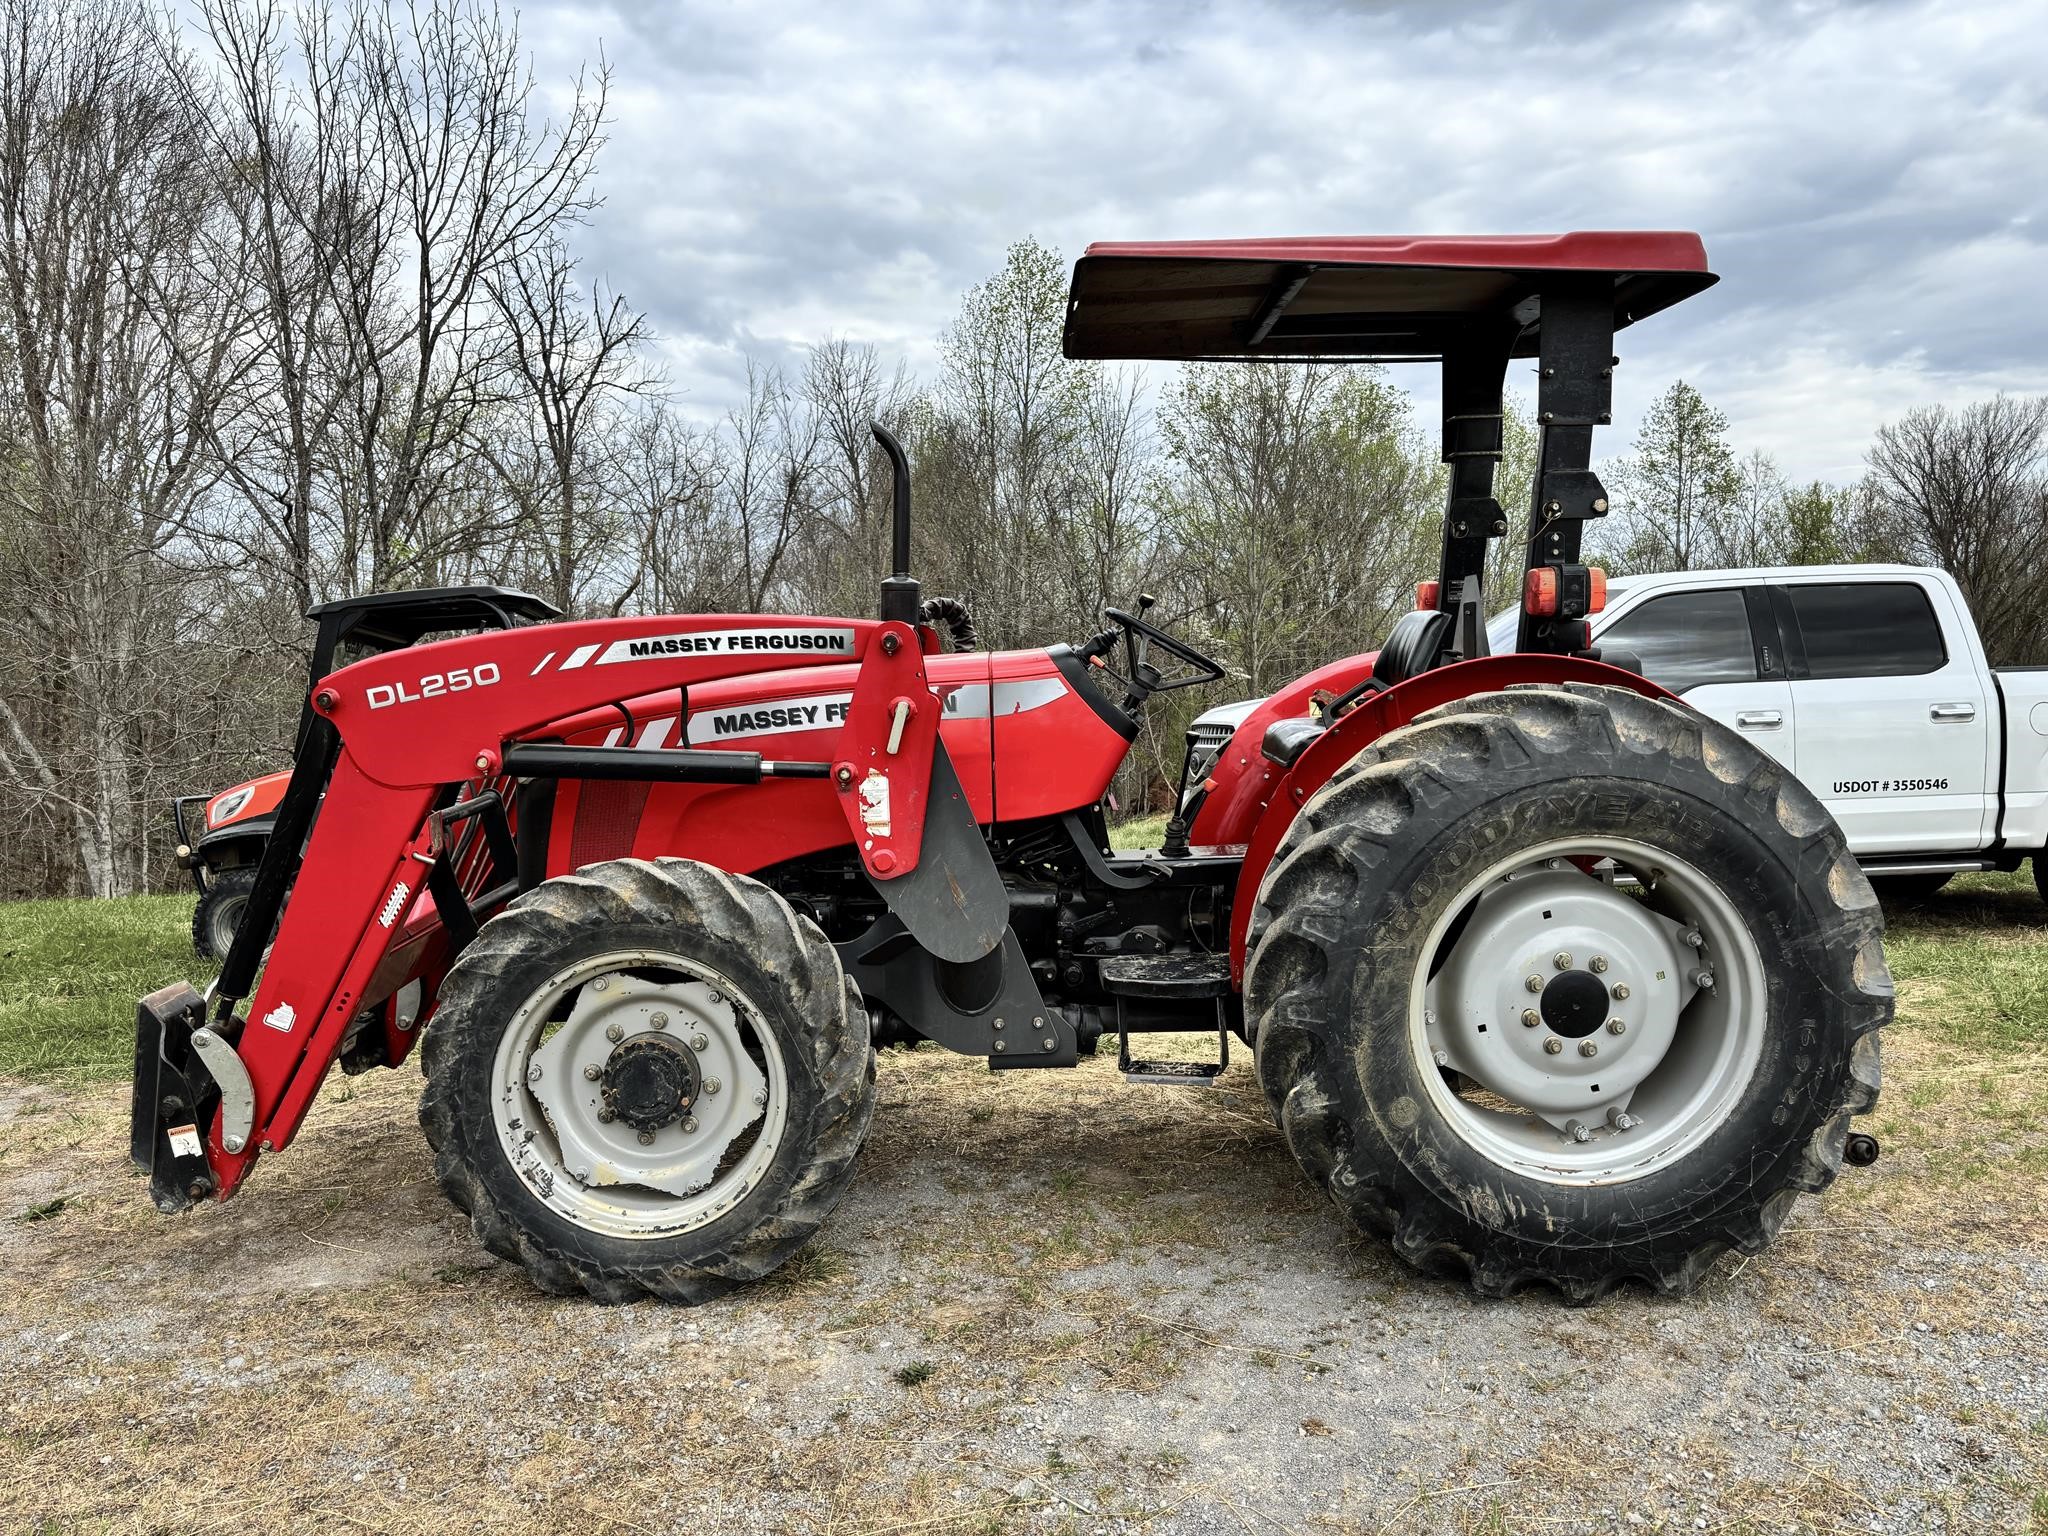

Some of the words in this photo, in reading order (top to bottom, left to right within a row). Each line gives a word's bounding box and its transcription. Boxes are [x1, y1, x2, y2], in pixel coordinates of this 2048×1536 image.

[629, 637, 722, 656] MASSEY
[727, 635, 845, 650] FERGUSON
[366, 662, 501, 710] DL250
[713, 705, 819, 735] MASSEY
[1833, 781, 1879, 793] USDOT
[1882, 781, 1890, 792] #
[1892, 778, 1948, 791] 3550546
